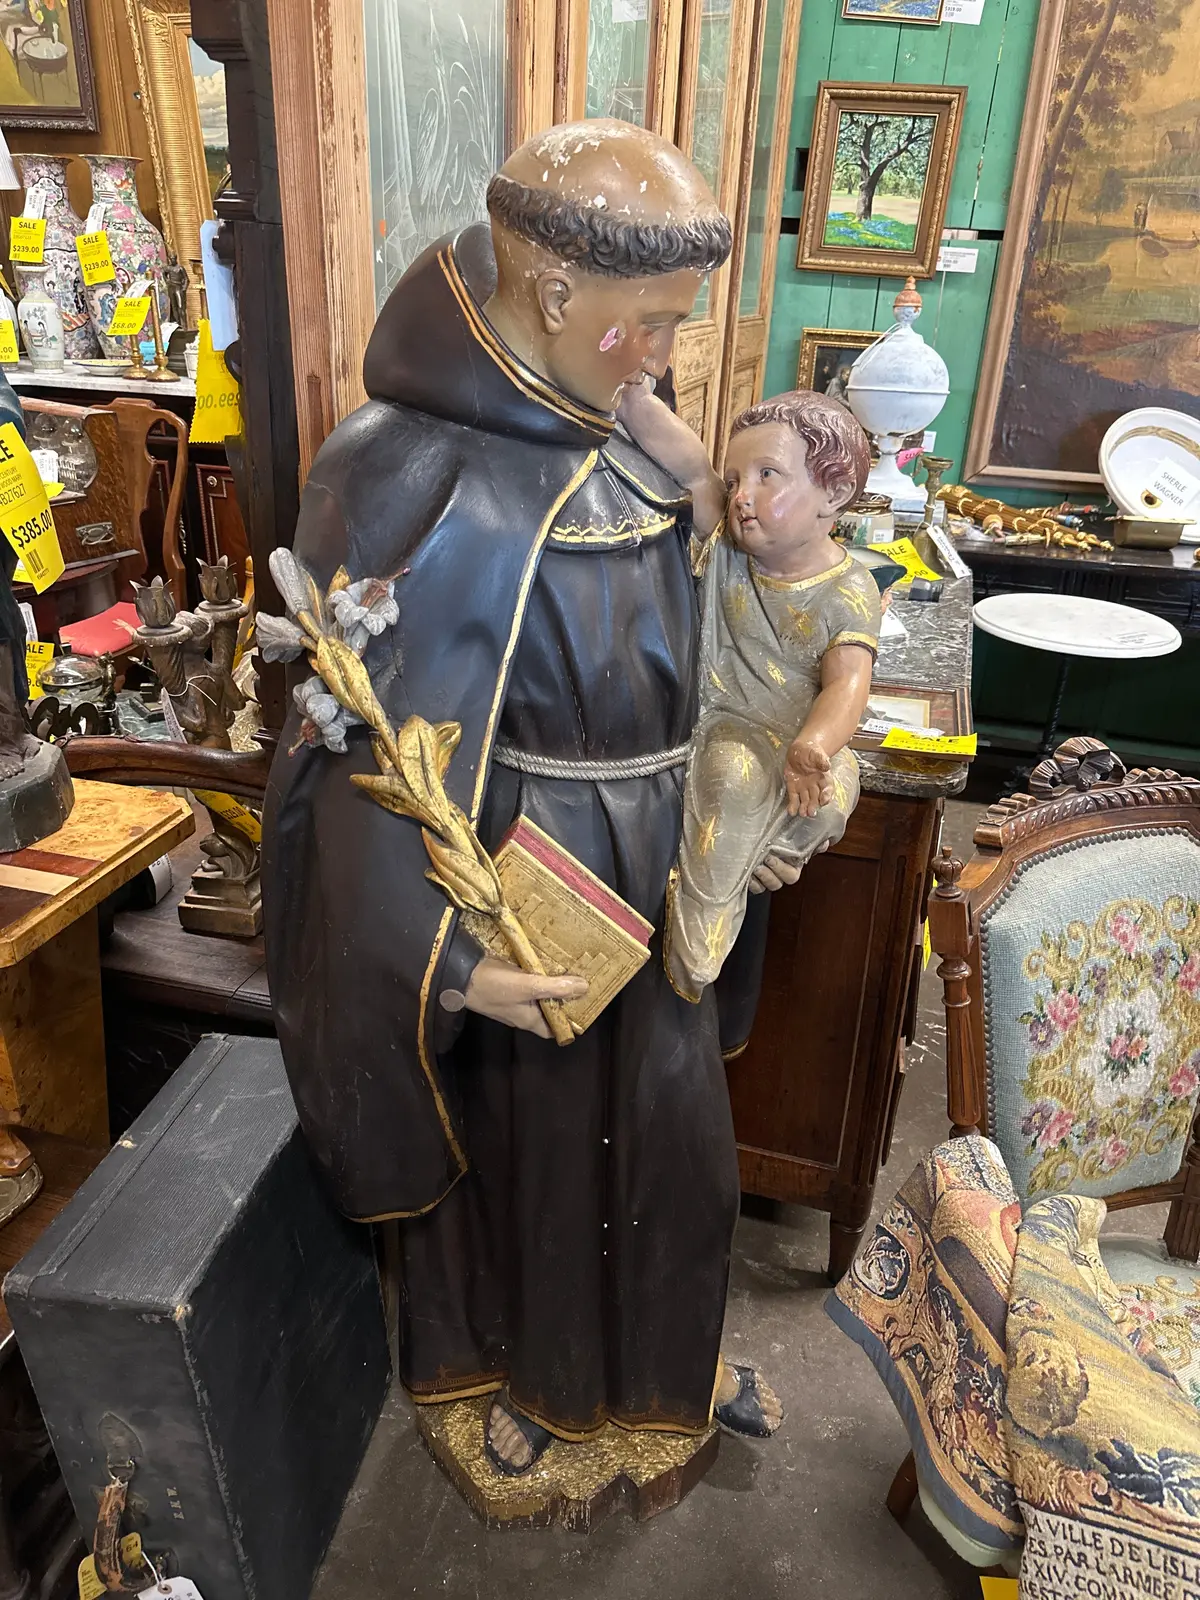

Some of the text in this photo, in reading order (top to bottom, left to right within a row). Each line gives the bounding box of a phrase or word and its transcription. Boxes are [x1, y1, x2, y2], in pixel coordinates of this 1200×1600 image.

[13, 245, 40, 253] $239.00
[83, 235, 99, 245] SALE
[84, 260, 109, 272] $239.00
[1161, 472, 1187, 492] SHERLE
[1153, 480, 1184, 506] WAGNER
[11, 509, 53, 549] $385.00
[26, 643, 44, 654] ALE
[1046, 1519, 1104, 1551] VILLE
[1110, 1537, 1141, 1562] DE
[1053, 1545, 1089, 1570] PAR
